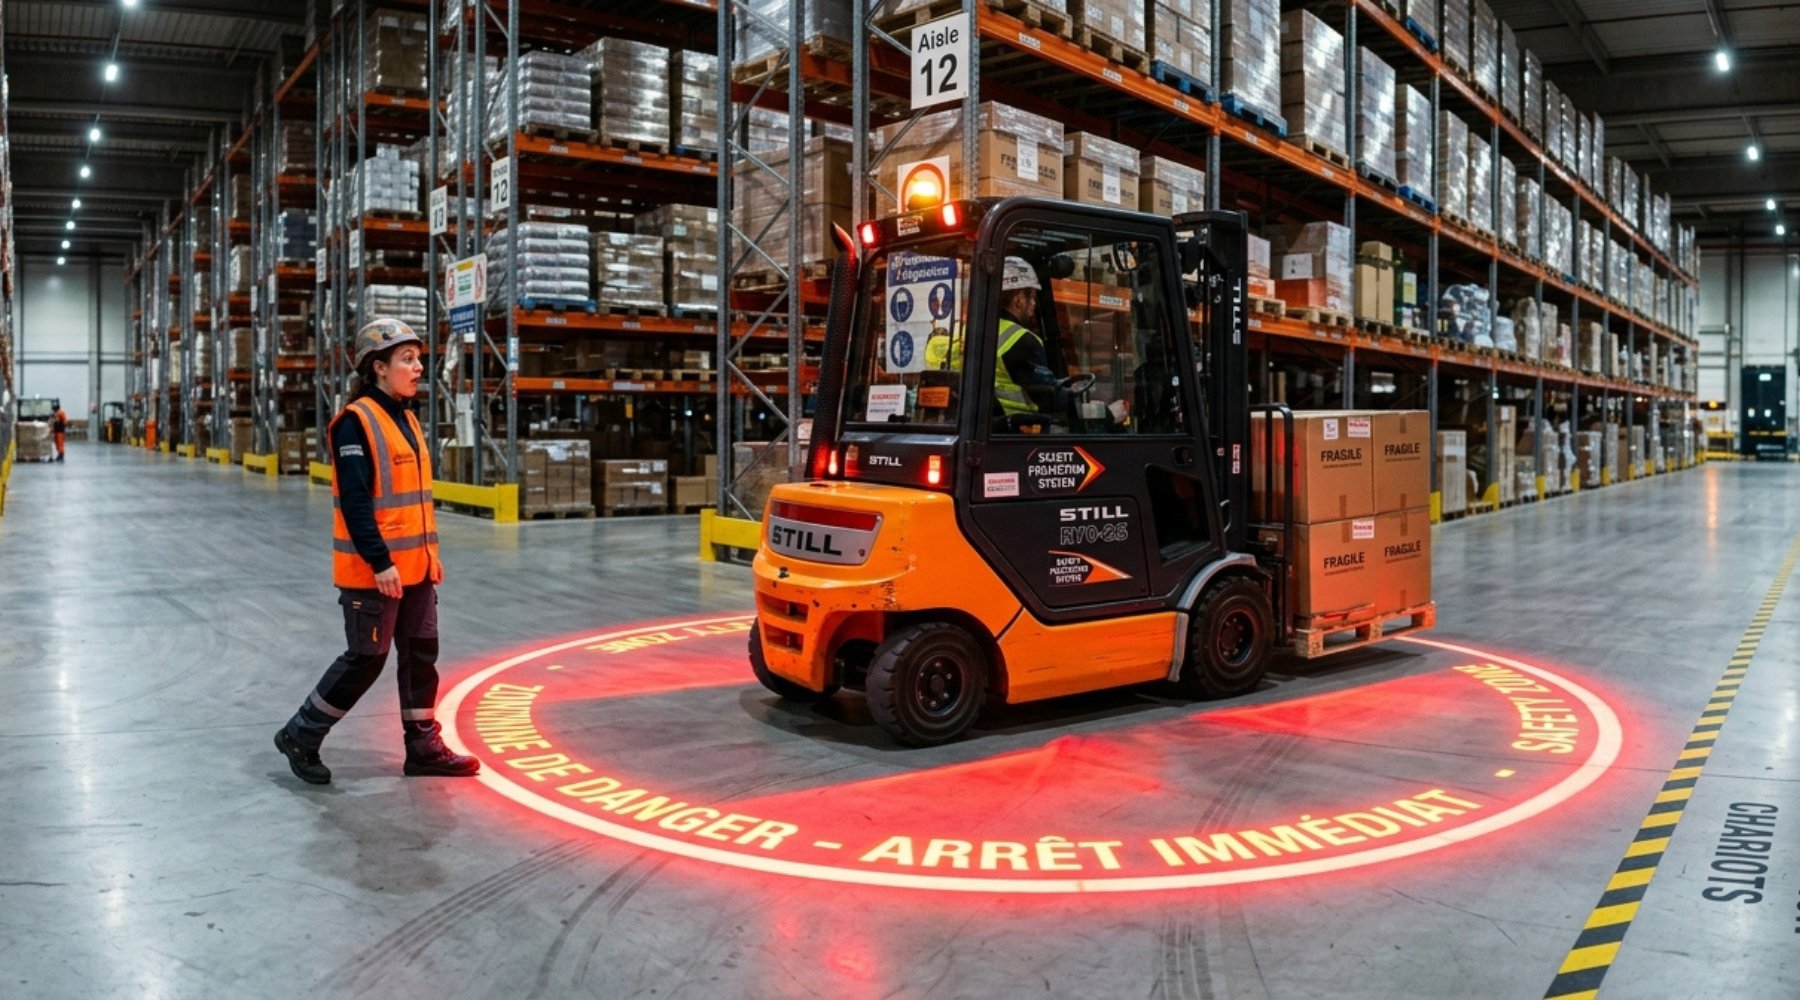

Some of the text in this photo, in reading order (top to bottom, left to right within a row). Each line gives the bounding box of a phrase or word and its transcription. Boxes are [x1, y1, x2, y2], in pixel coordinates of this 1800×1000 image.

[918, 26, 959, 53] Aisle
[920, 53, 957, 97] 12
[1232, 278, 1242, 345] STILL
[868, 455, 903, 467] STILL
[1384, 442, 1421, 456] FRAGILE
[1059, 505, 1130, 522] STILL
[771, 524, 843, 556] STILL
[1322, 551, 1365, 569] FRAGILE
[503, 752, 595, 782] DE
[555, 777, 799, 850] DANGER
[858, 836, 1124, 872] ARRÊT
[1149, 788, 1483, 867] IMMÉDIAT
[1508, 695, 1580, 754] SAFETY
[1701, 802, 1779, 904] CHARIOTS
